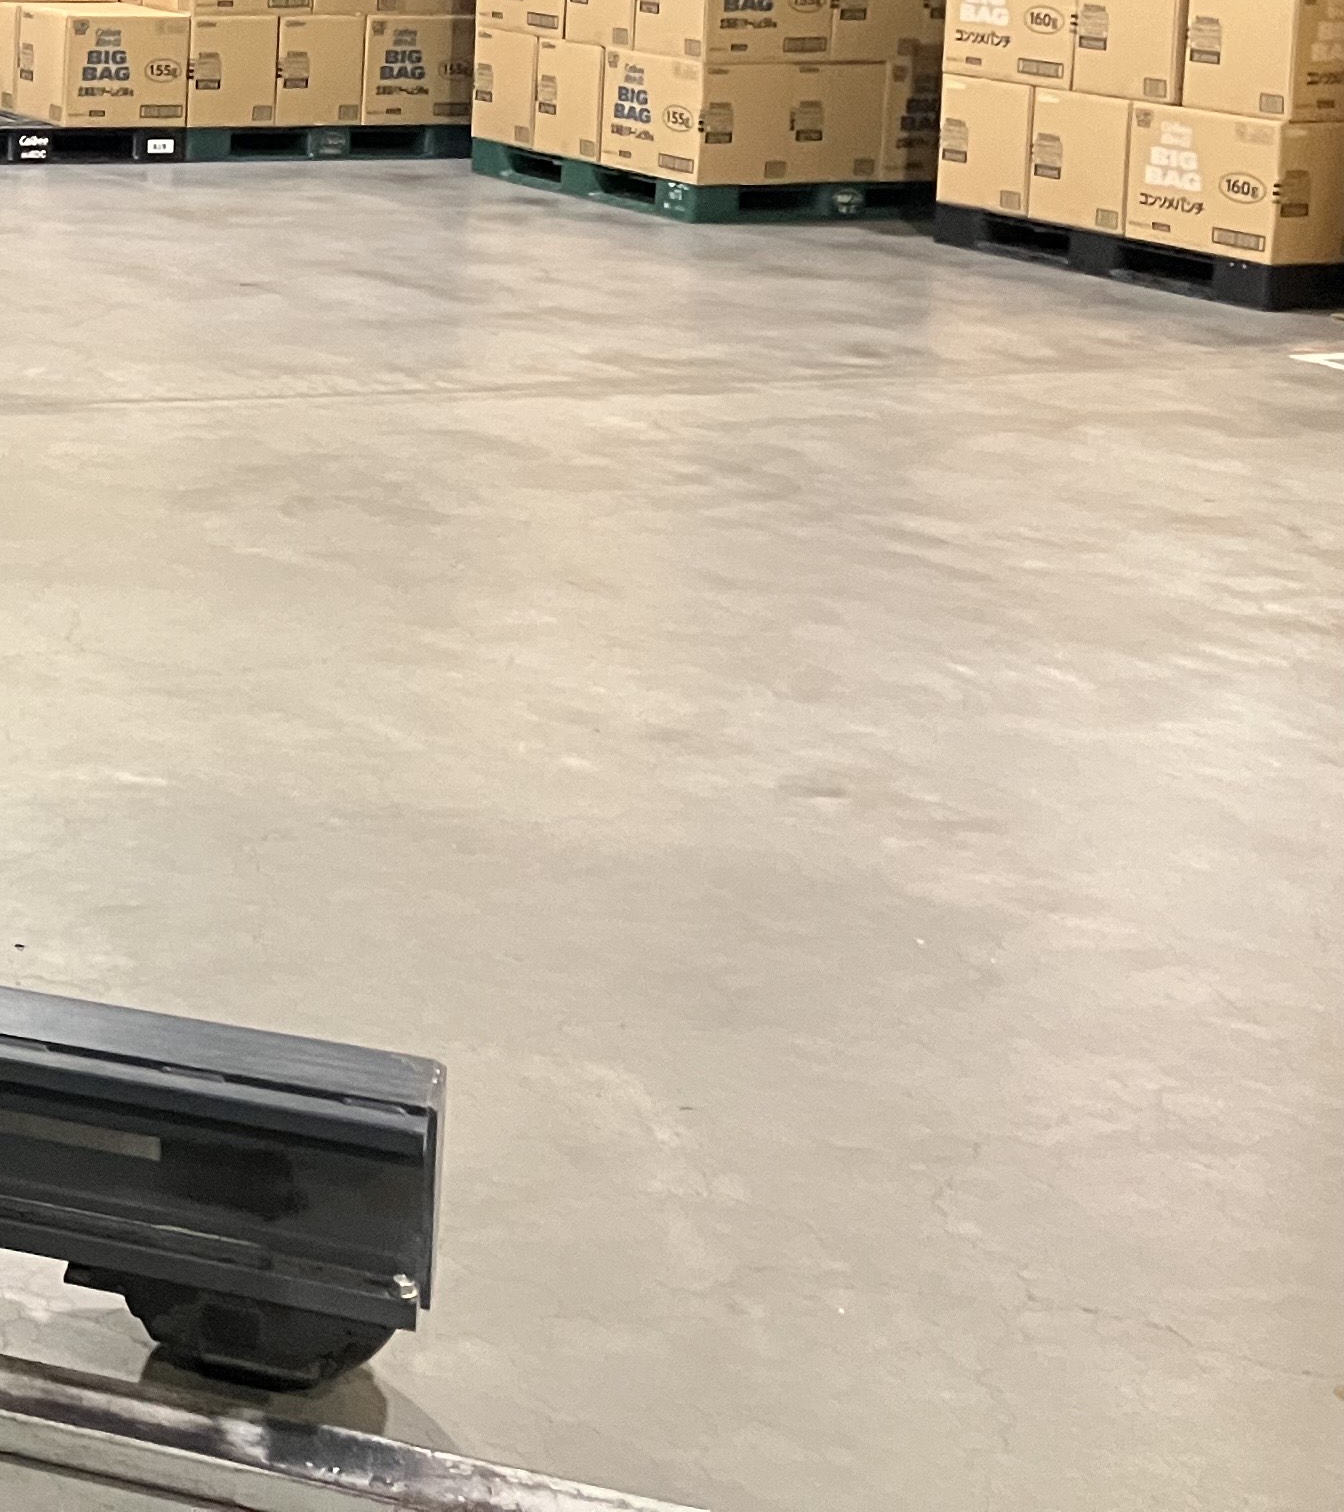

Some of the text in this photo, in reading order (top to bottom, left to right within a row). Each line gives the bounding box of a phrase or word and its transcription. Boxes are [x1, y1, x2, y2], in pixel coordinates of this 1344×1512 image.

[959, 4, 1010, 26] BAG
[1029, 11, 1058, 30] 160g
[87, 50, 127, 65] BIG
[384, 50, 422, 64] BIG
[82, 67, 130, 81] BAG
[149, 64, 178, 78] 155g
[379, 66, 425, 80] BAG
[617, 86, 648, 105] BIG
[613, 103, 651, 124] BAG
[1150, 146, 1198, 170] BIG
[1144, 165, 1202, 192] BAG
[1225, 178, 1259, 198] 160g
